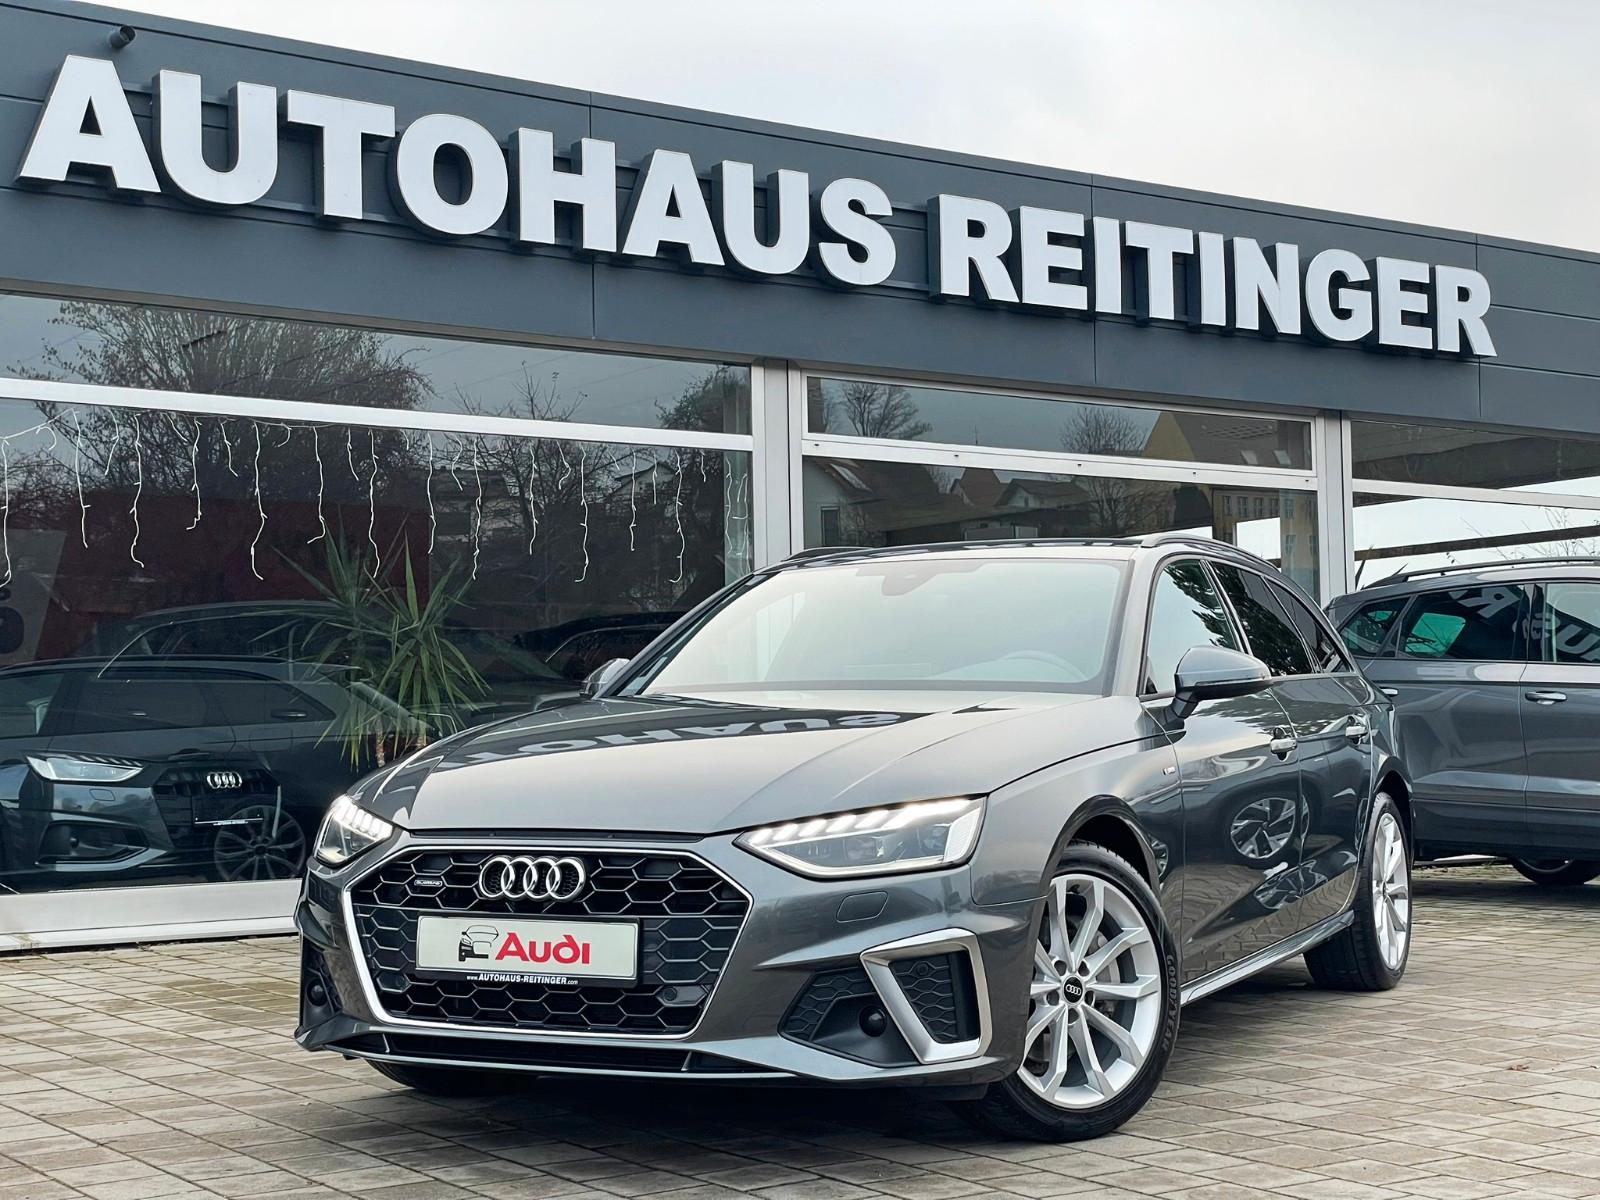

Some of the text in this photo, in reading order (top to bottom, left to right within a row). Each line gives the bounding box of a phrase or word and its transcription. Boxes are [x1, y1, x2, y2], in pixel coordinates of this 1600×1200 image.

[19, 54, 1498, 358] AUTOHAUS REITINGER
[495, 931, 591, 965] Audi
[466, 973, 579, 985] www.AUTOHAUS-REITINGER.com
